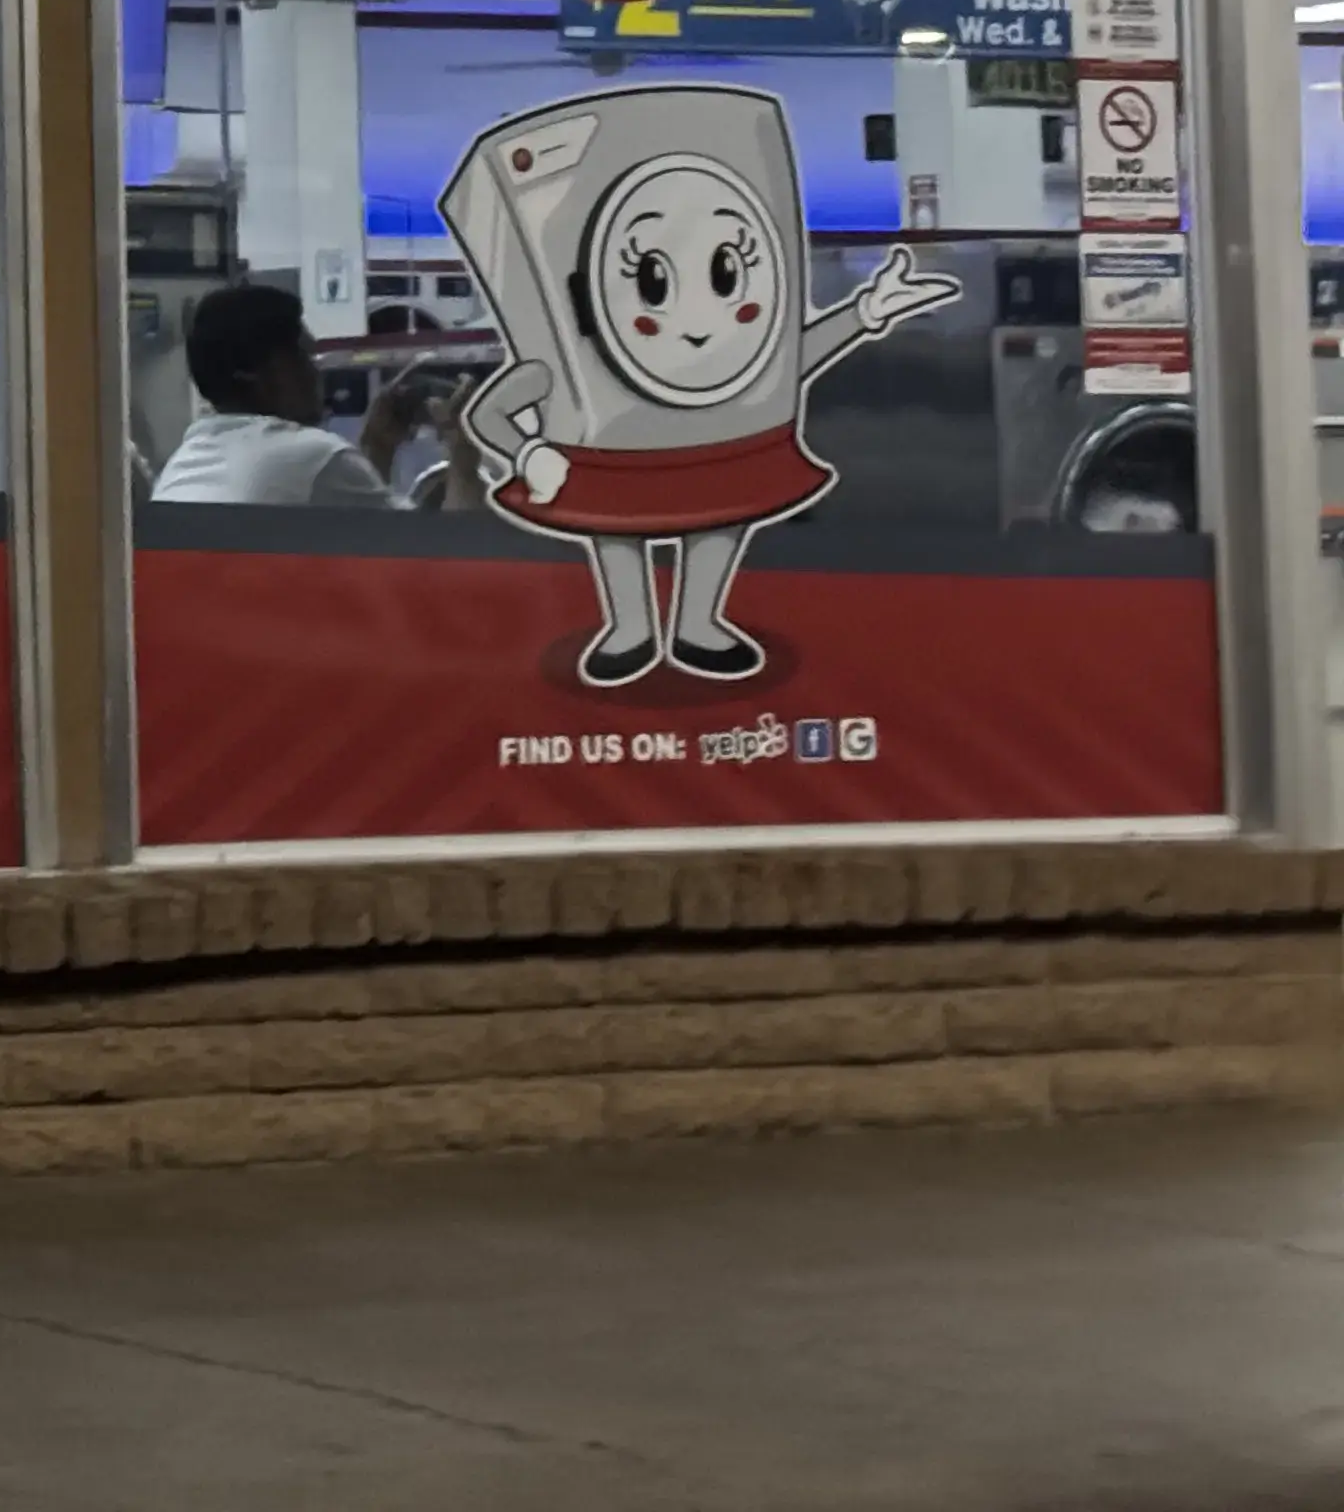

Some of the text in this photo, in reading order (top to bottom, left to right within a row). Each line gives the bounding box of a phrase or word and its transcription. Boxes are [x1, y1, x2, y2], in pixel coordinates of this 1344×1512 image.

[1116, 159, 1144, 174] NO
[499, 735, 572, 768] FIND
[581, 733, 624, 765] US
[630, 732, 687, 764] ON:
